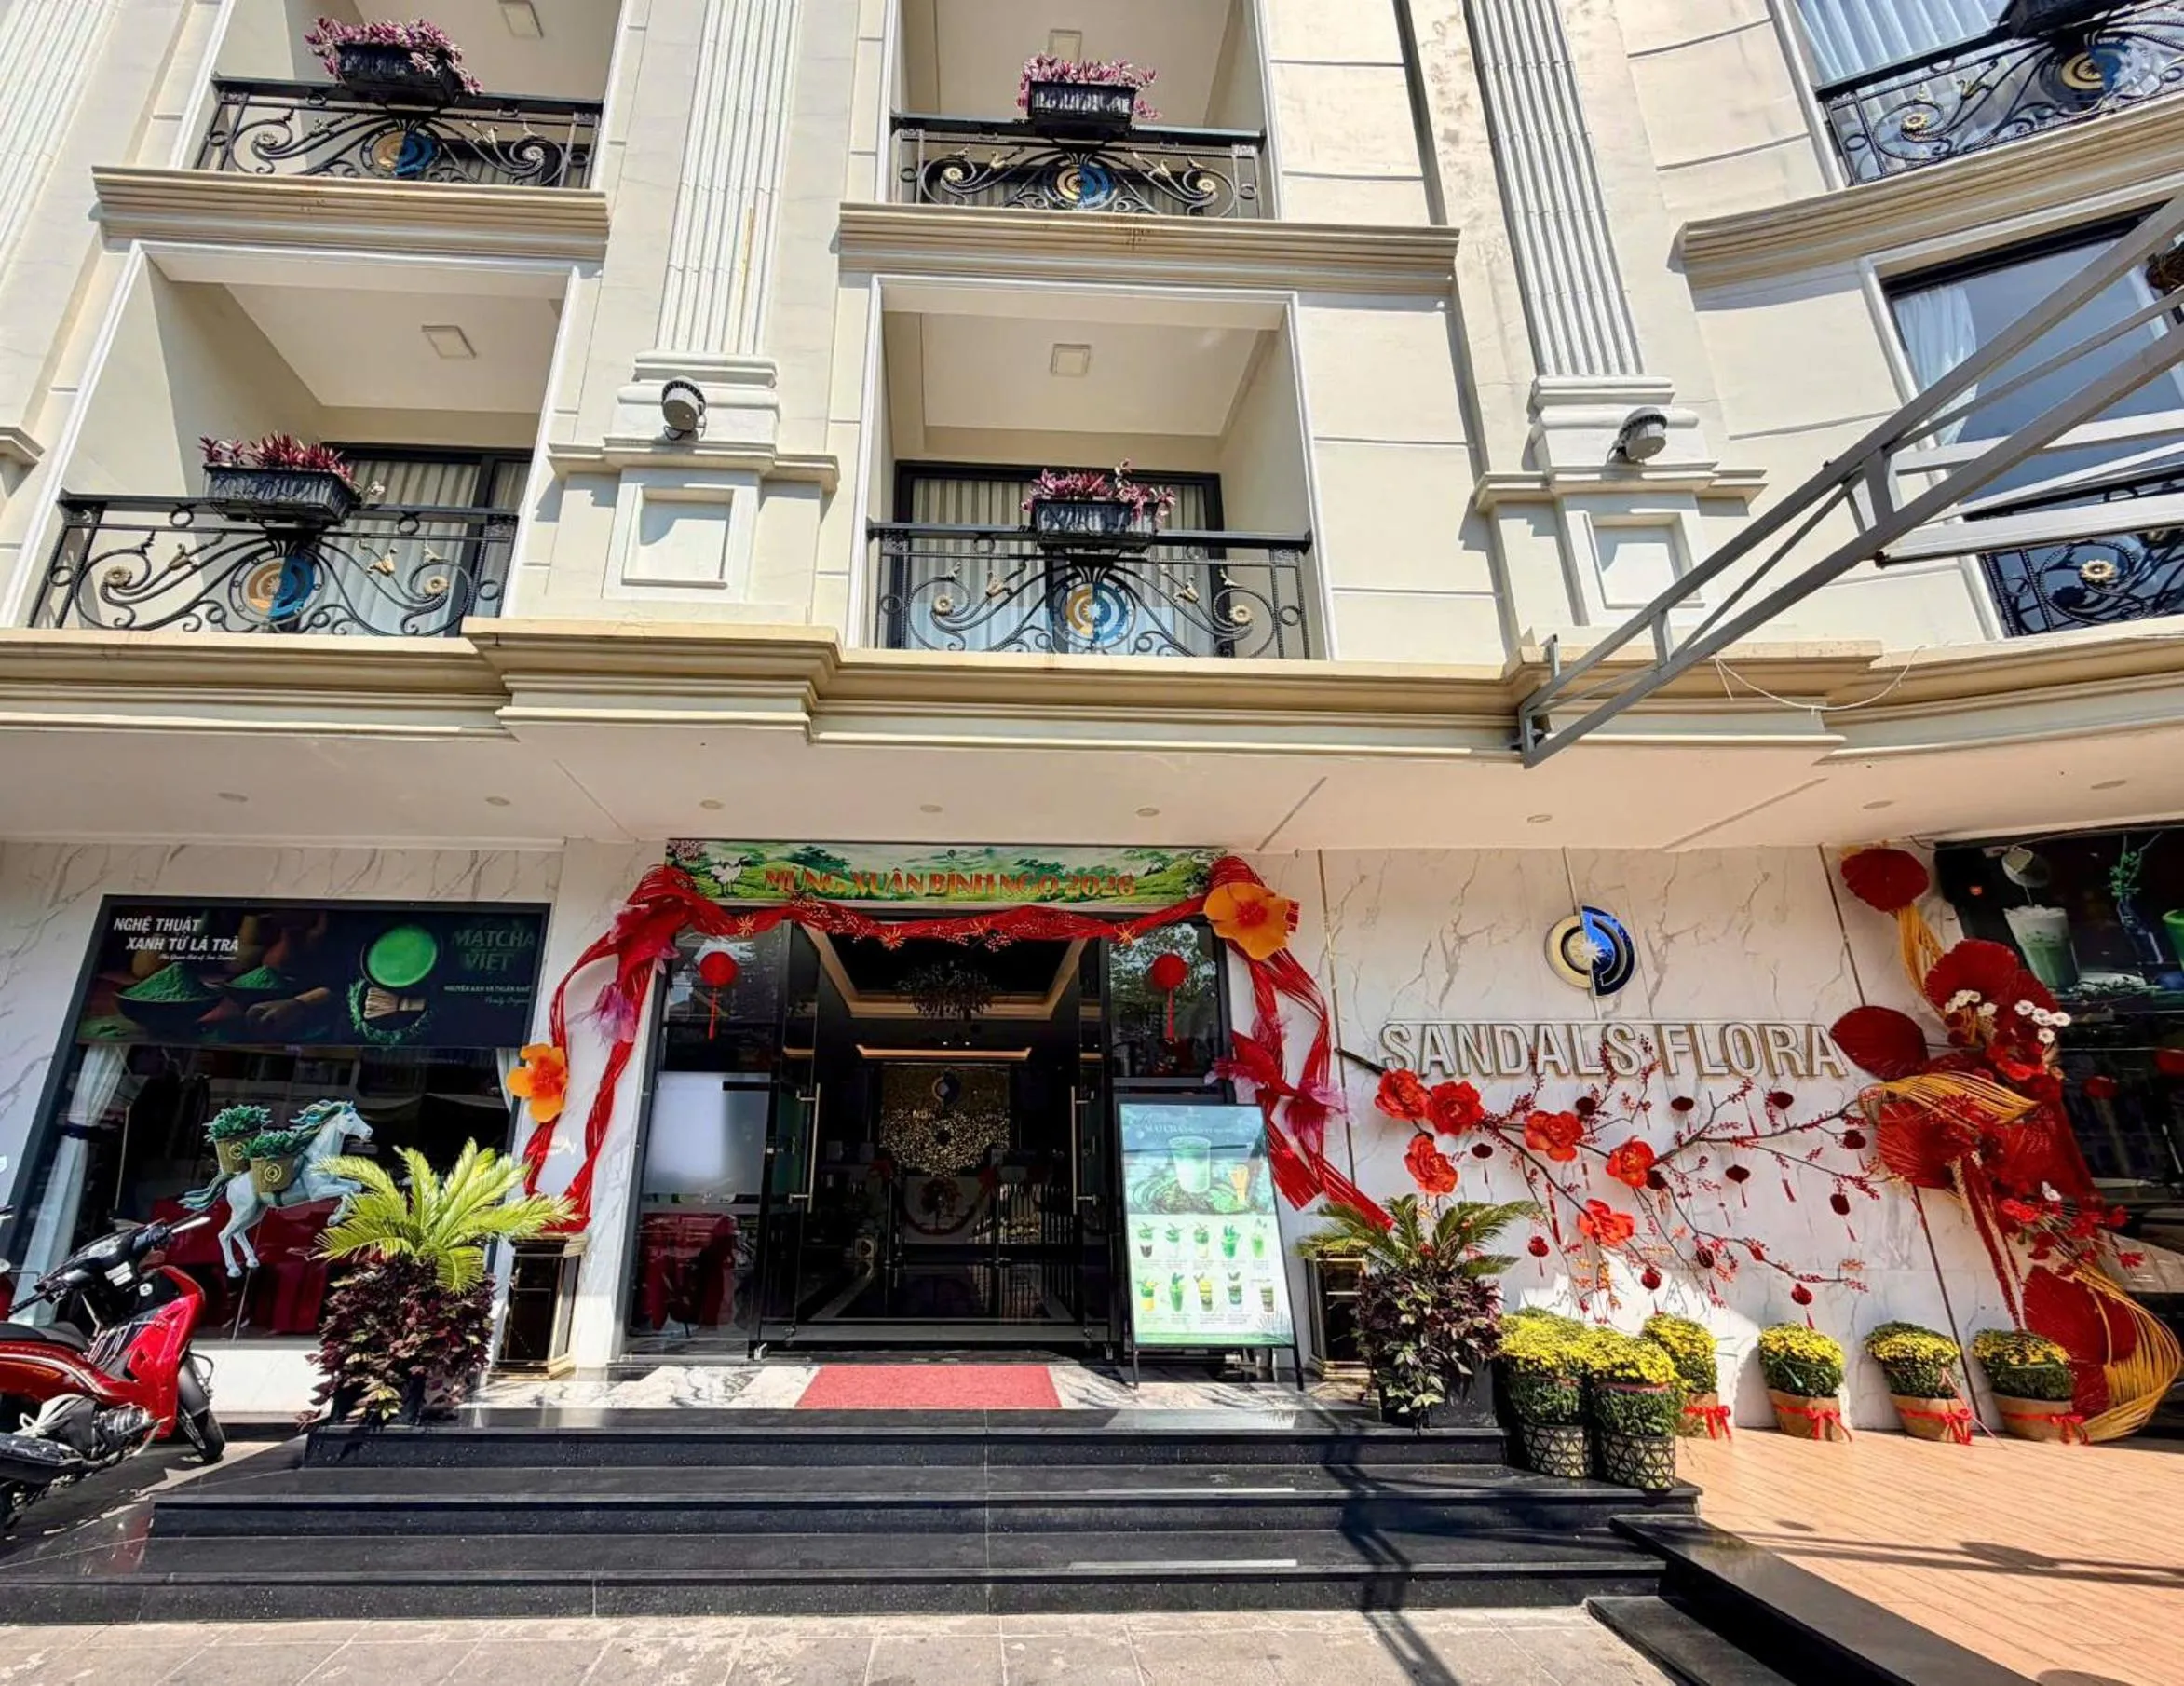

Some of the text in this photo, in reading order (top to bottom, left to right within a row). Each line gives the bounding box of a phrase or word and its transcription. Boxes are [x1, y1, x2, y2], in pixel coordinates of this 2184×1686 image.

[114, 916, 152, 933] NGHỆ
[126, 936, 165, 951] XANH
[190, 935, 209, 951] LÁ
[453, 929, 535, 947] MATCHA
[1380, 1022, 1849, 1078] SANDALS FLORA
